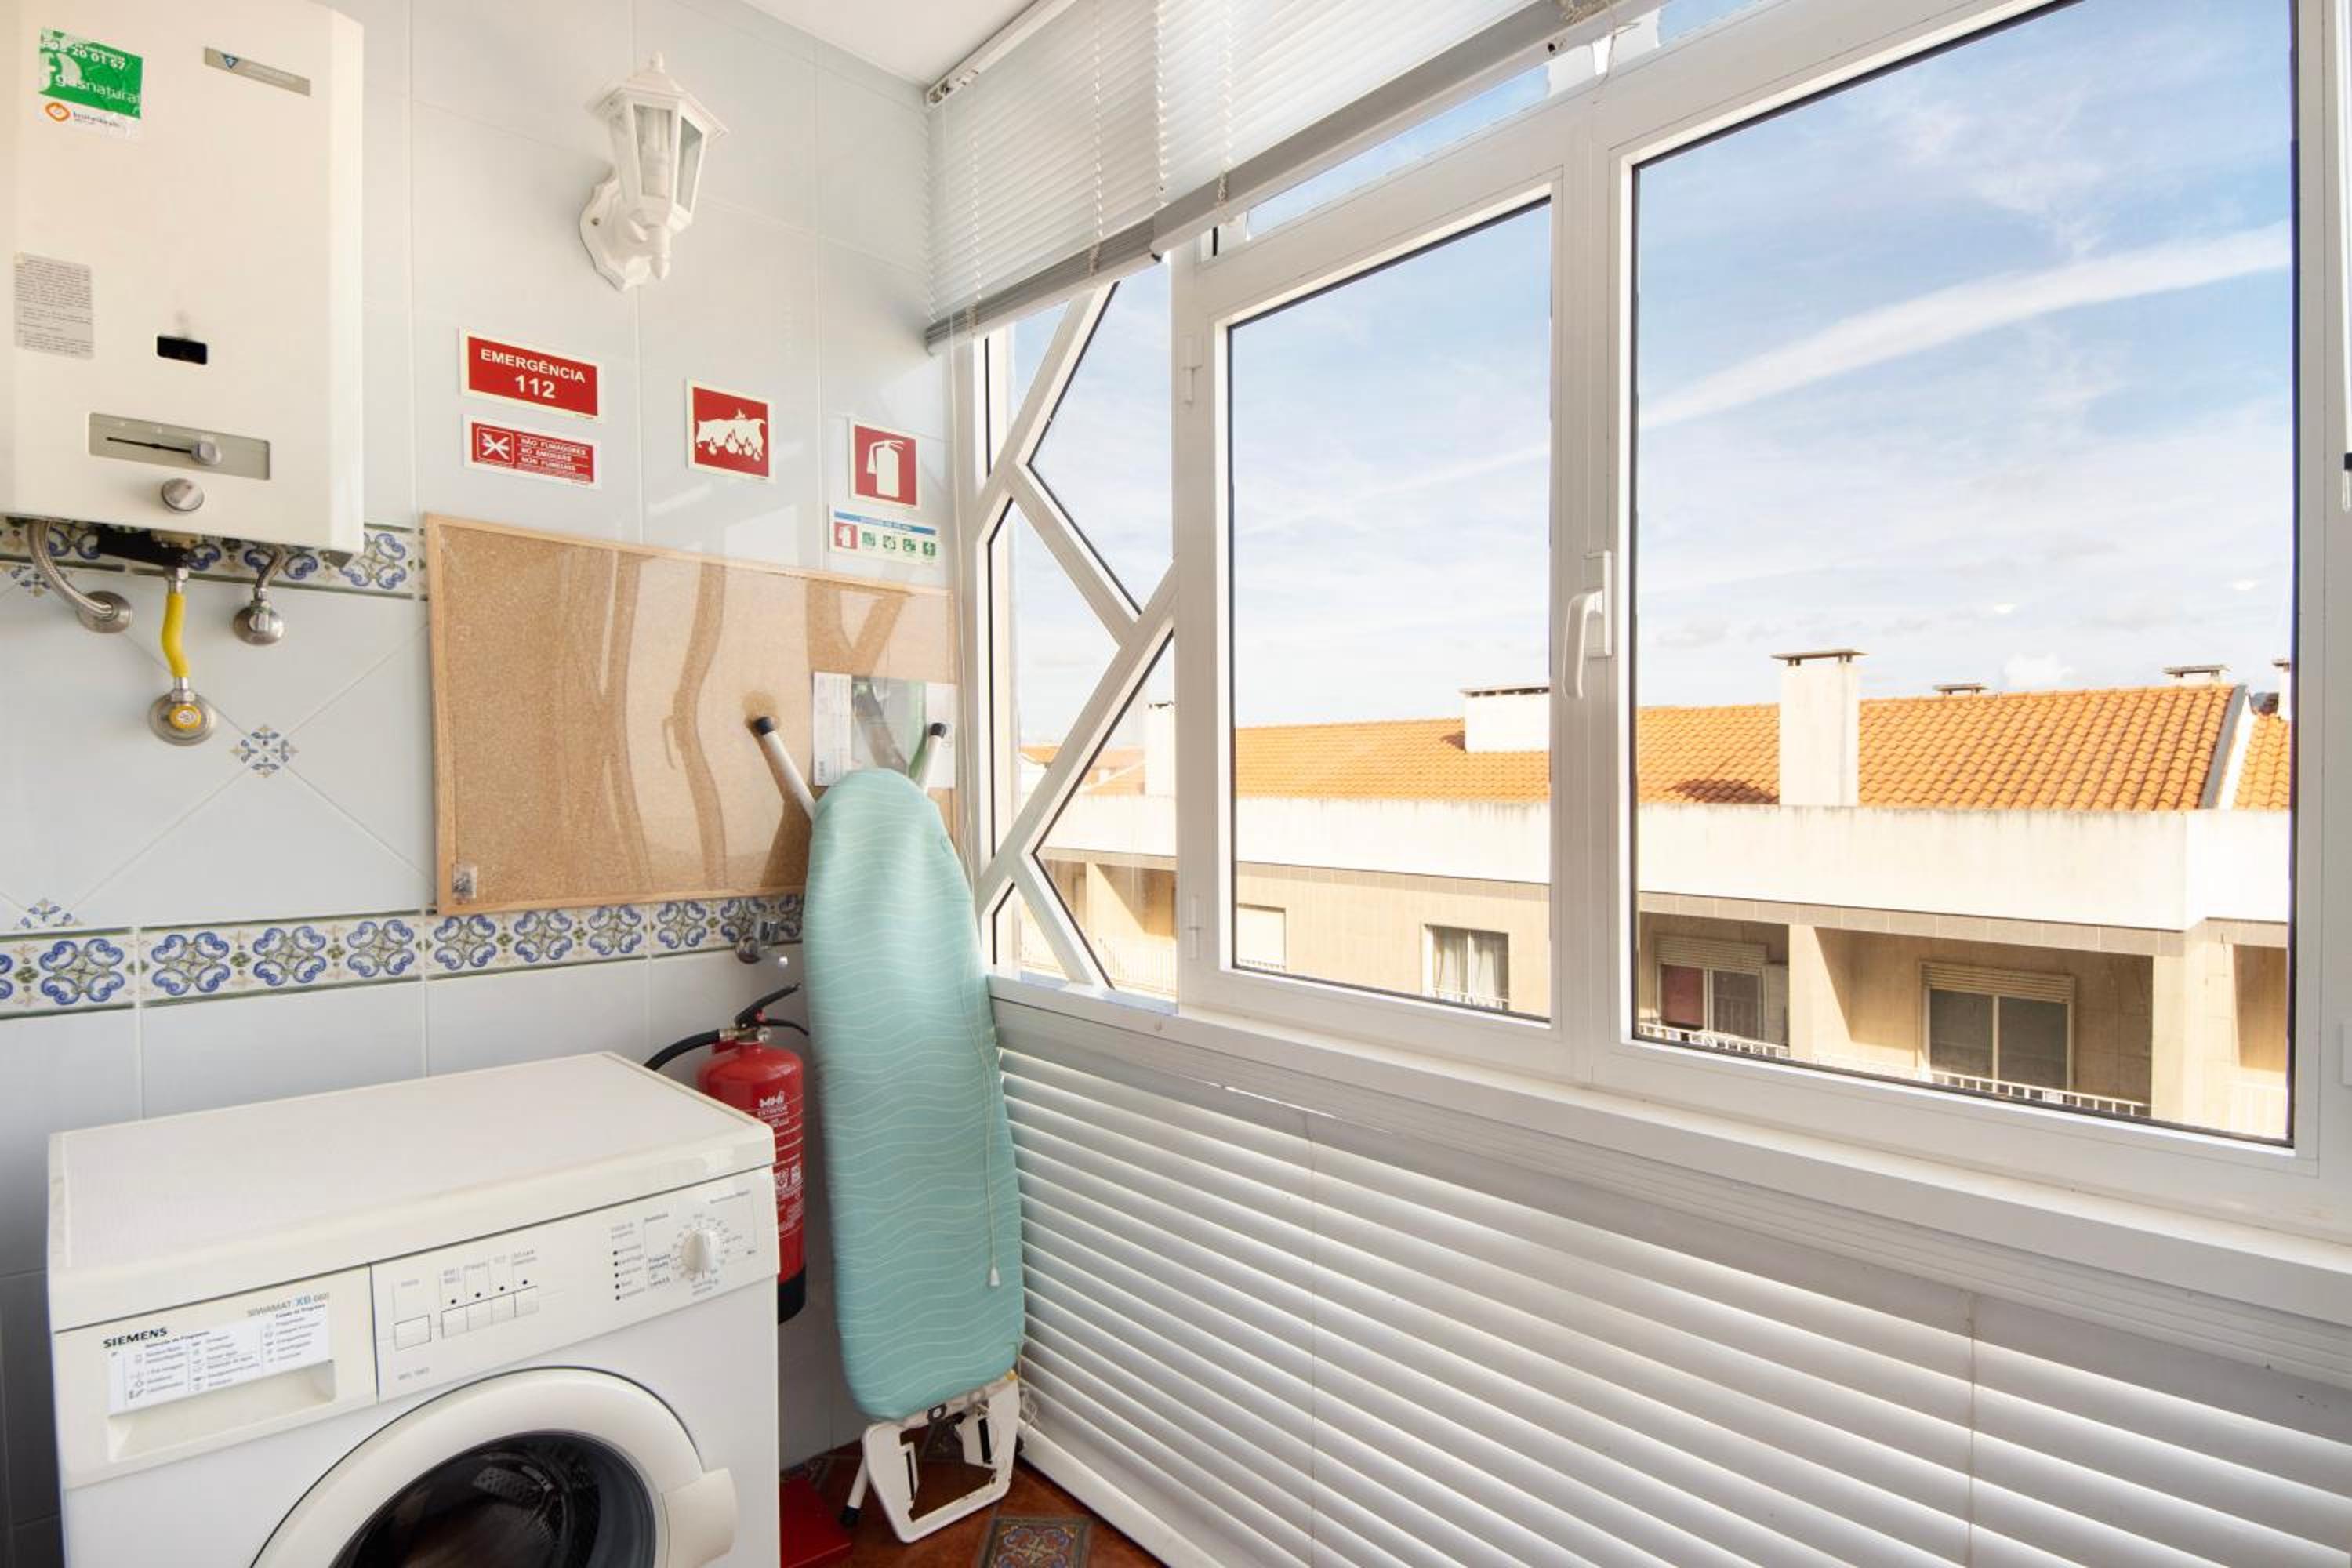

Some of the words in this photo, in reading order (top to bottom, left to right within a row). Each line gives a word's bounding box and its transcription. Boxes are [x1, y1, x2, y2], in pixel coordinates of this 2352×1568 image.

[481, 348, 585, 383] EMERGÊNCIA
[515, 374, 556, 399] 112
[103, 1327, 168, 1348] SIEMENS
